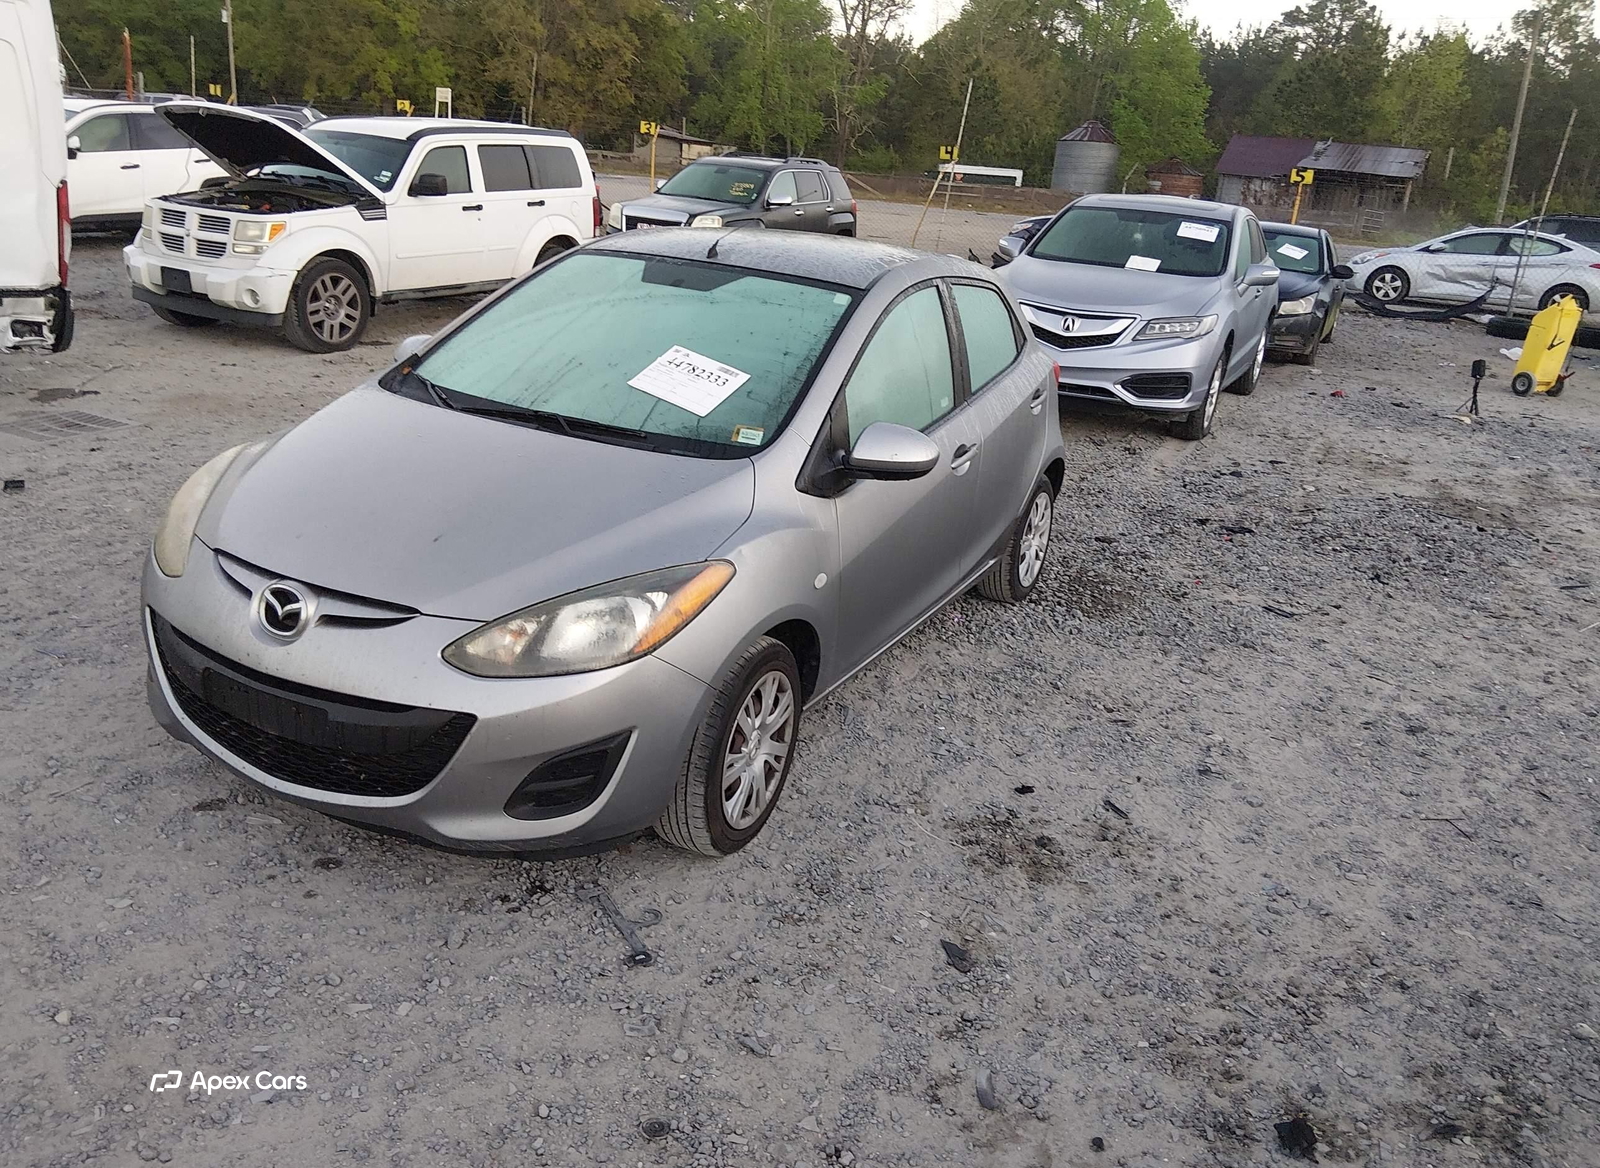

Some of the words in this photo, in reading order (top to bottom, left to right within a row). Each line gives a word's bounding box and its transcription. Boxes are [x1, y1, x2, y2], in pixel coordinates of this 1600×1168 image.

[643, 122, 652, 135] 3
[944, 145, 954, 160] 4
[1294, 168, 1308, 183] 5
[666, 356, 729, 387] 44782333
